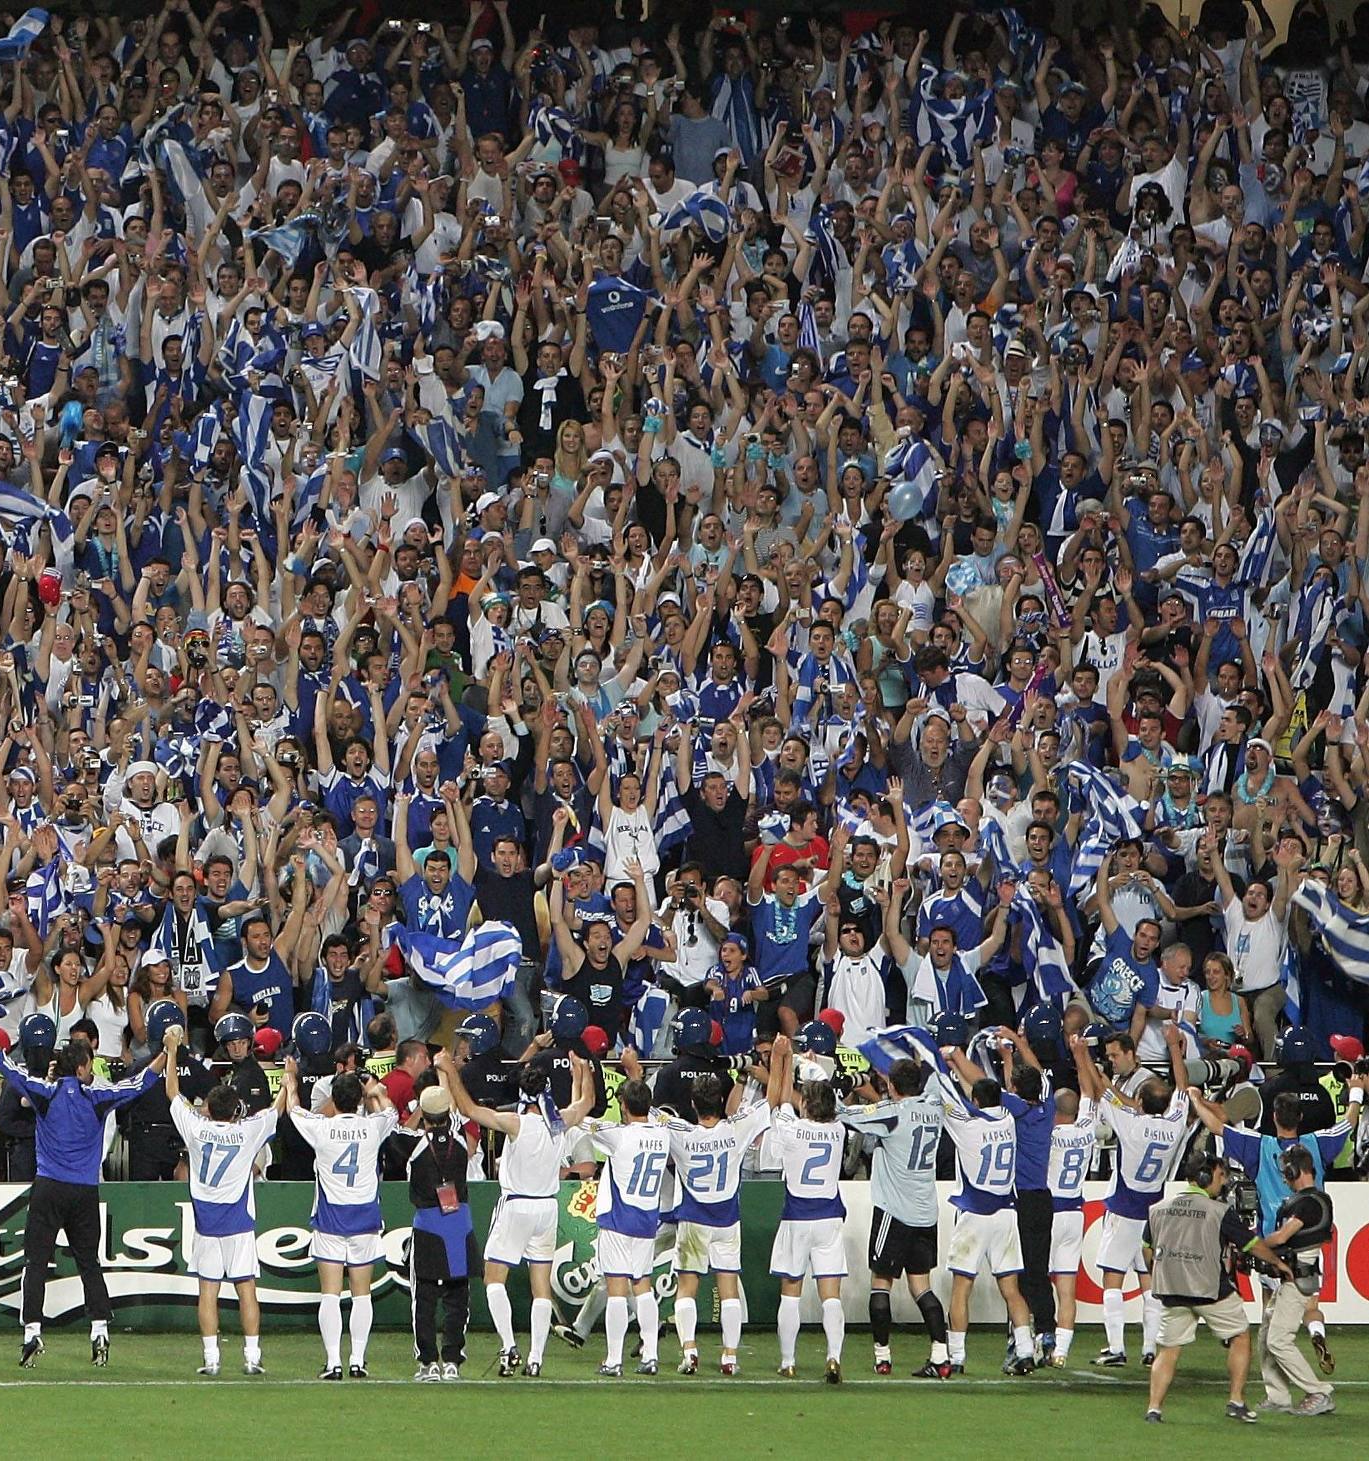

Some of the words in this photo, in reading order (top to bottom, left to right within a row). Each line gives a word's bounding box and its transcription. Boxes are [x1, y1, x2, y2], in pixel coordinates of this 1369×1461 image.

[1139, 893, 1151, 905] 10
[1112, 957, 1145, 993] GREECE
[729, 996, 738, 1013] 9
[329, 1128, 368, 1140] DABIZAS
[638, 1139, 663, 1152] KAFES
[684, 1137, 736, 1153] KATSOURANIS
[795, 1129, 840, 1143] GIOURKAS
[907, 1124, 939, 1170] 12
[982, 1129, 1013, 1144] KAPSIS
[199, 1142, 241, 1188] 17
[331, 1142, 360, 1188] 4
[626, 1151, 667, 1198] 16
[686, 1151, 729, 1192] 21
[800, 1142, 832, 1186] 2
[975, 1142, 1015, 1186] 19
[1058, 1148, 1085, 1190] 8
[1133, 1141, 1170, 1182] 6
